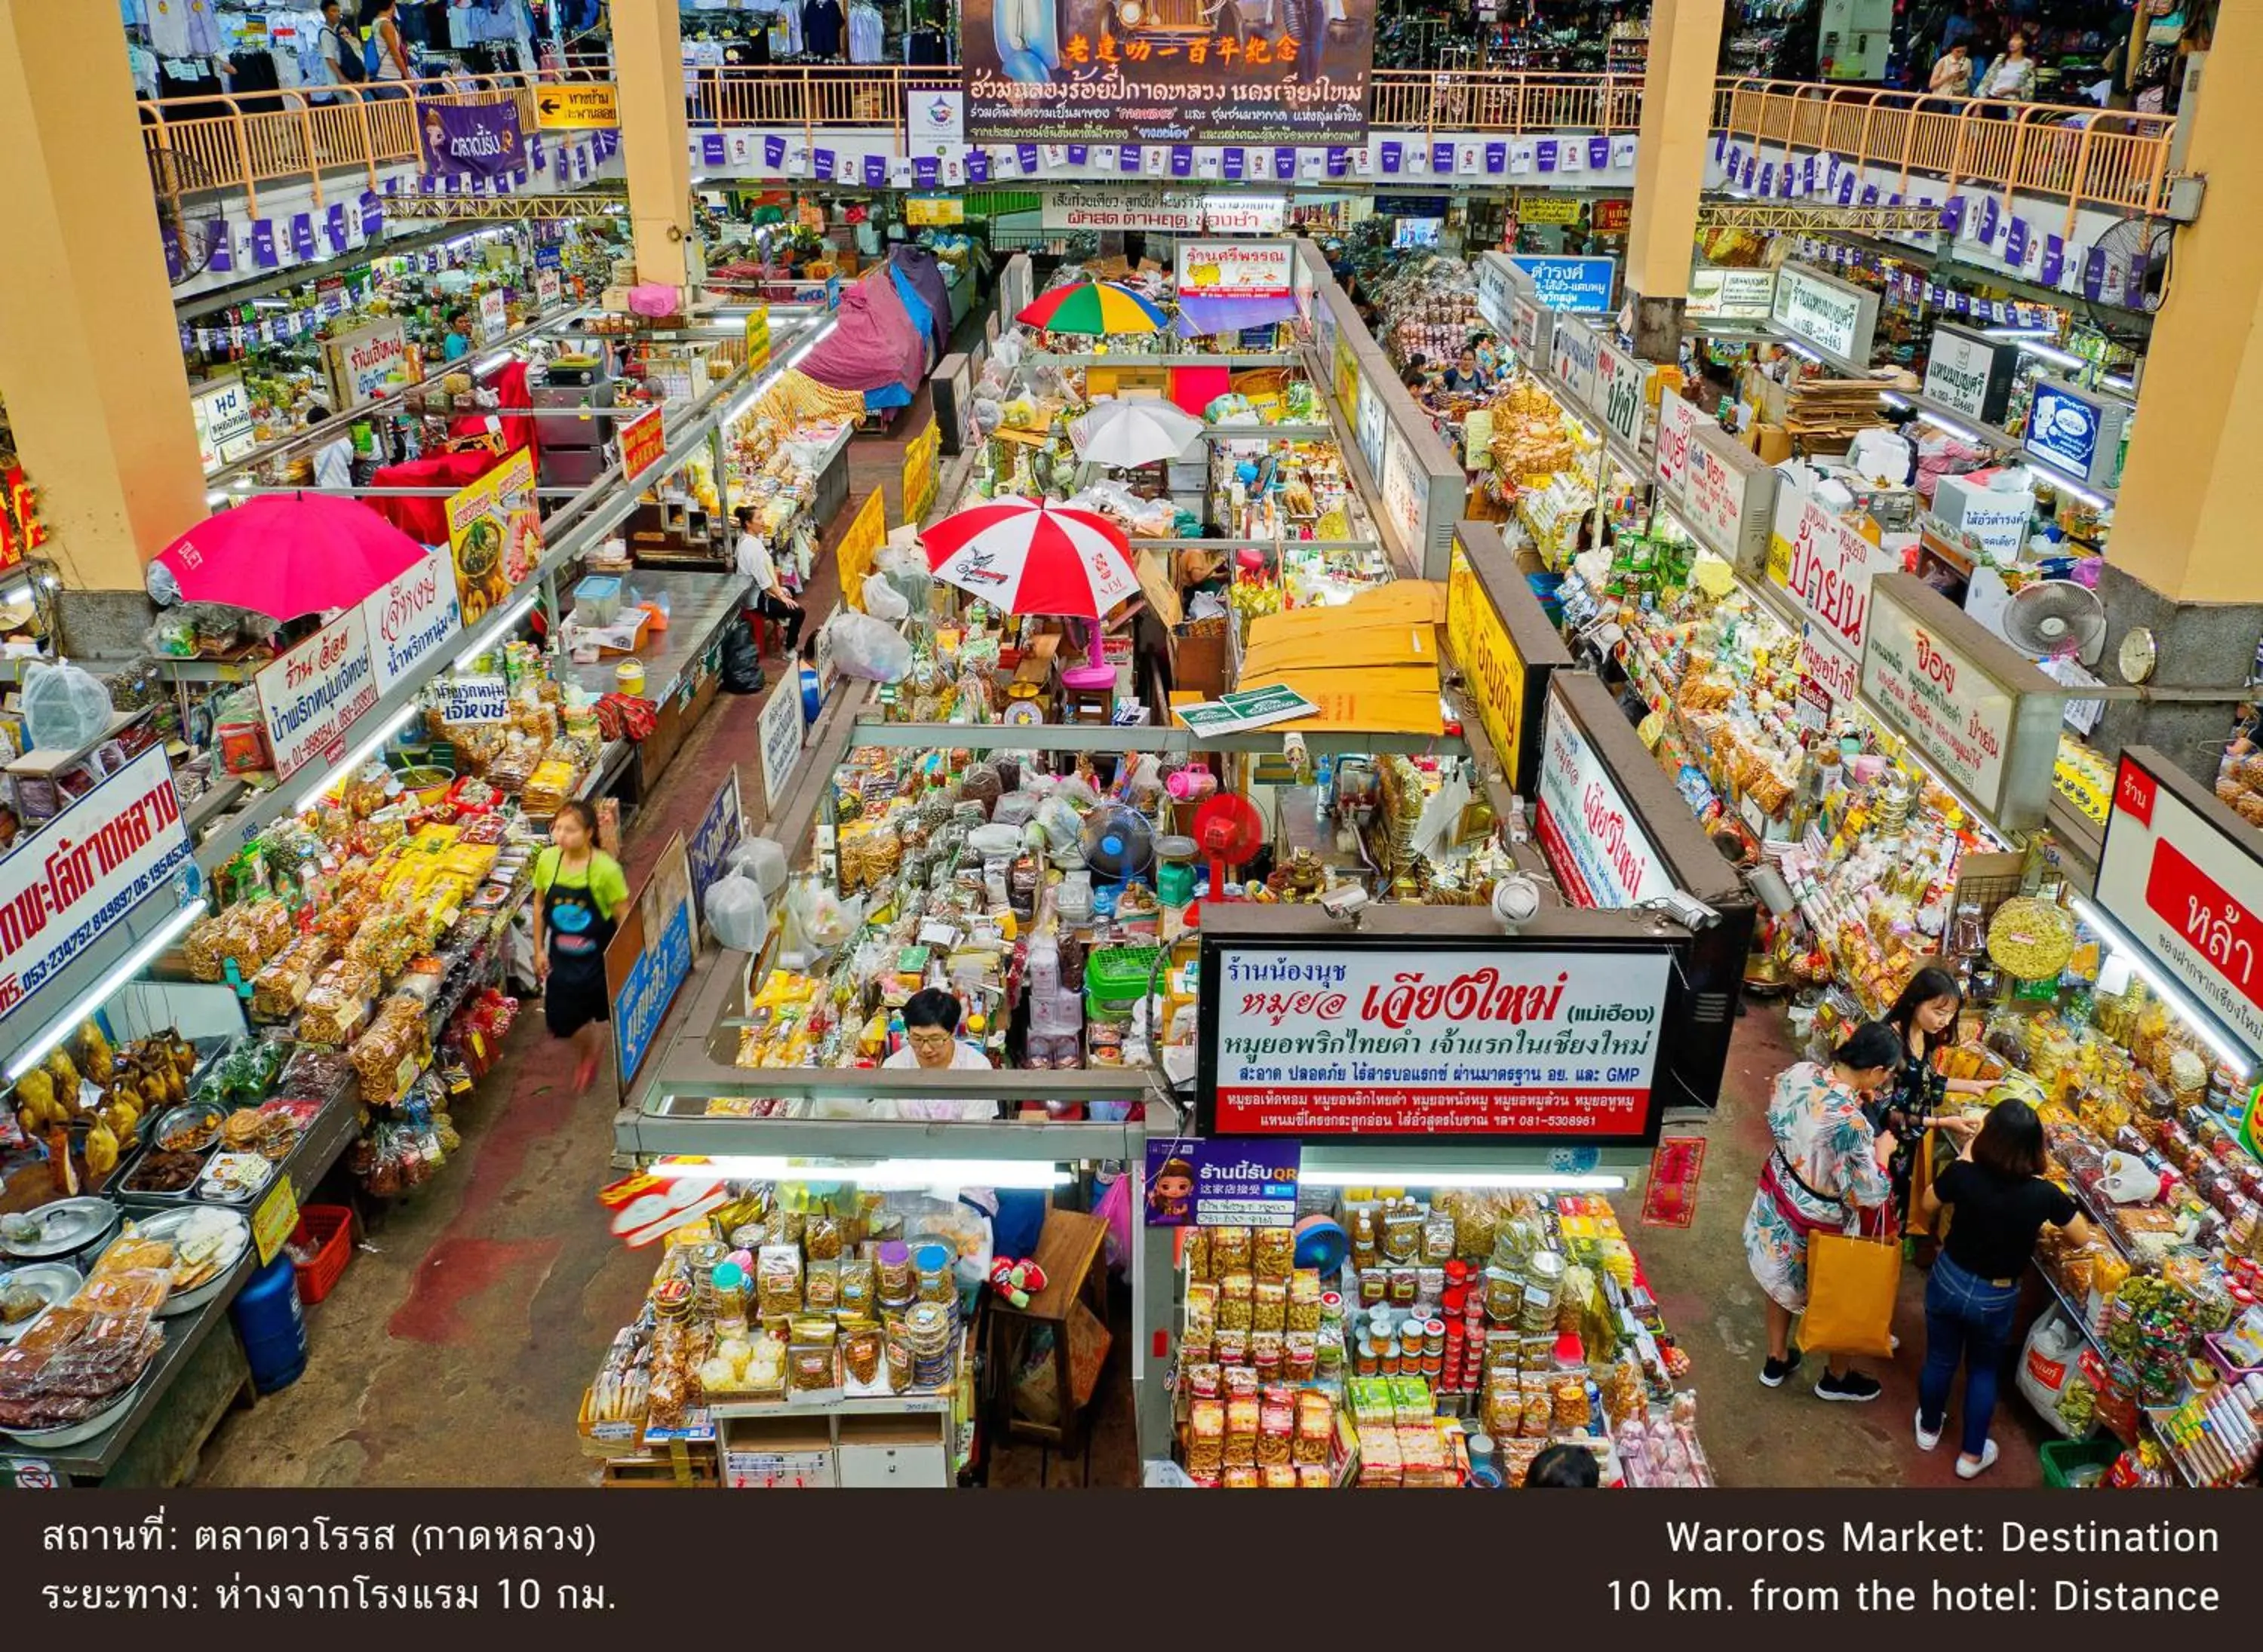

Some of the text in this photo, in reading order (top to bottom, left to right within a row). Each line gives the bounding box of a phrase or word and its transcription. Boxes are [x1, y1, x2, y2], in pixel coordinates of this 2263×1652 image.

[1789, 518, 1866, 646] ป้าย่น
[284, 625, 350, 692] ร้าน อ้อย
[387, 616, 450, 677] น้ำพริกหนุ่ม
[2123, 772, 2148, 811] ร้าน
[2188, 895, 2254, 985] หล้า
[1227, 957, 1346, 990] ร้านน้องนุช
[1238, 989, 1349, 1027] หมูยอ
[1567, 1003, 1656, 1025] (แม่เฮือง)
[1224, 1025, 1652, 1067] หมูยอพริกไทยดำ เจ้าแรกในเชียงใหม่
[1239, 1061, 1640, 1087] สะอาด ปลอดภัย ไร้สารบอแรกซ์ ผ่านมาตรฐาน อย. และ GMP
[1227, 1091, 1308, 1111] หมูยอเห็ดหอม
[1313, 1091, 1408, 1111] หมูยอพริกไทยดำ
[1411, 1092, 1489, 1112] หมูยอหนังหมู
[1199, 1159, 1299, 1184] ร้านนี้รับ QR
